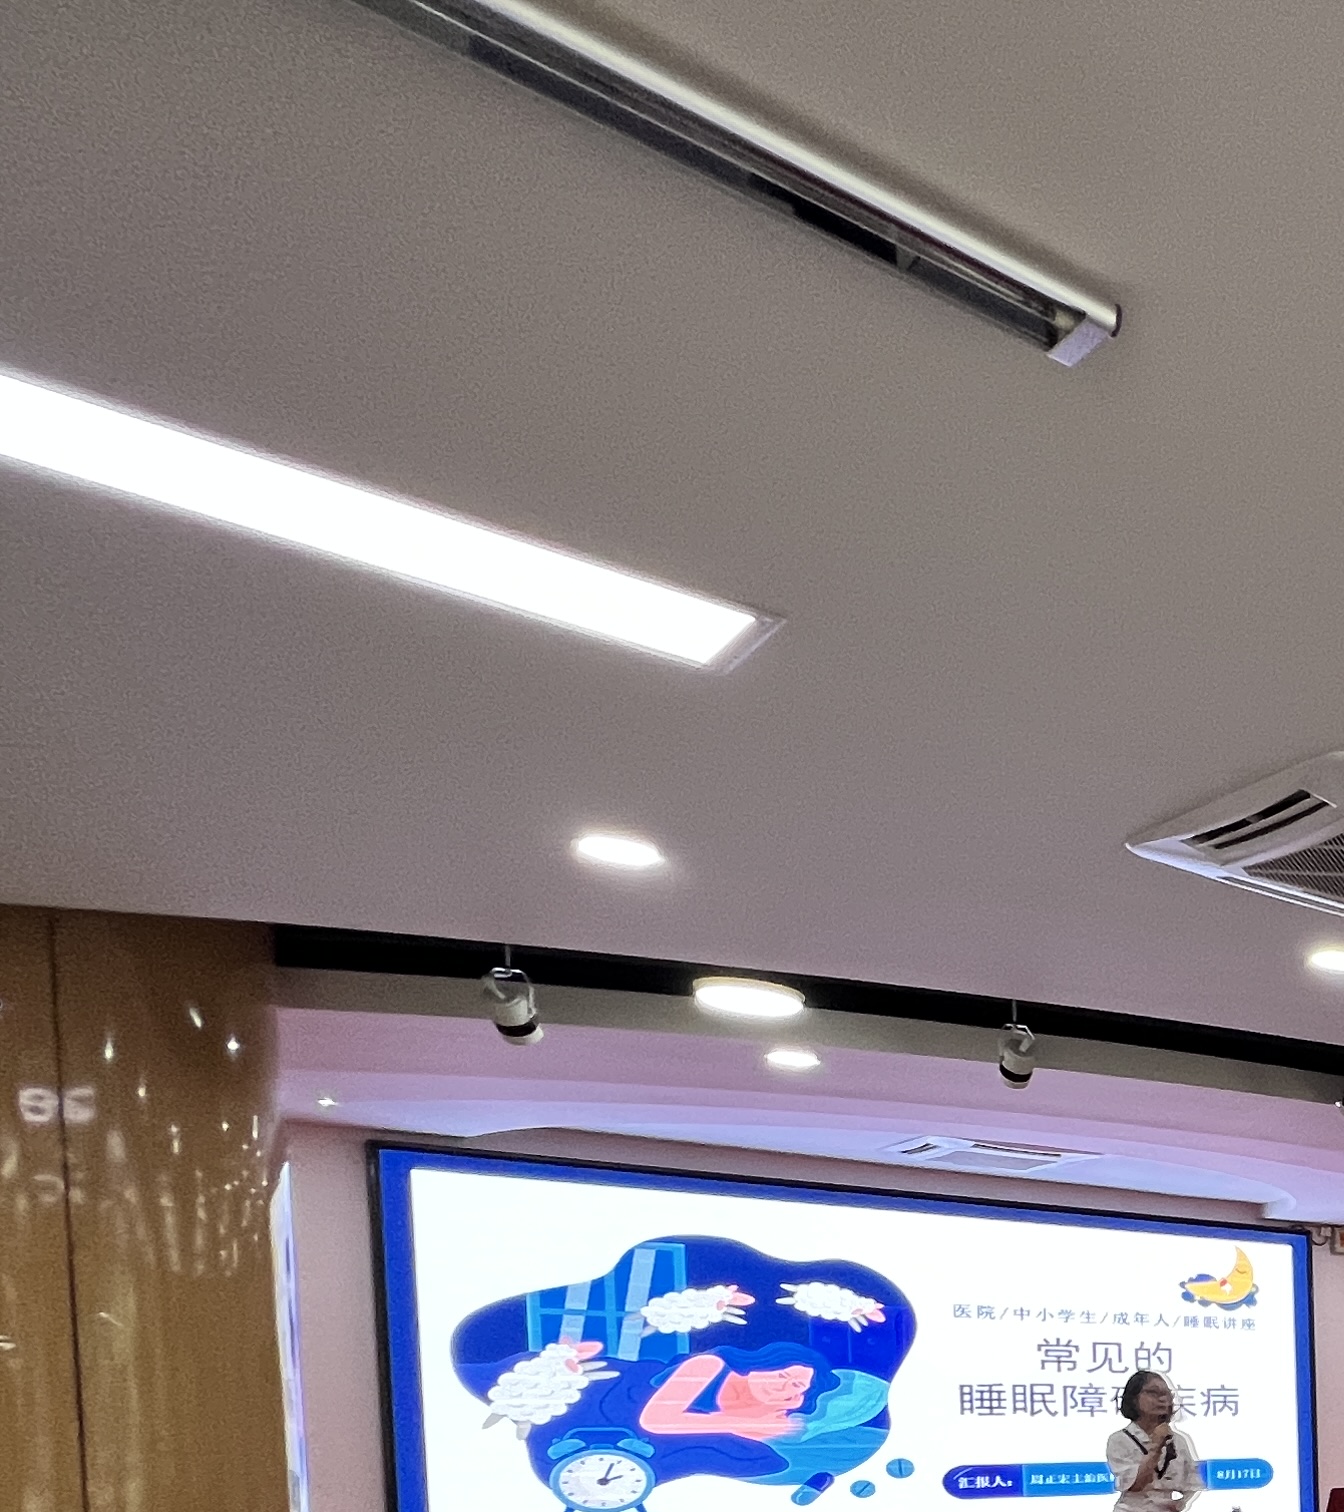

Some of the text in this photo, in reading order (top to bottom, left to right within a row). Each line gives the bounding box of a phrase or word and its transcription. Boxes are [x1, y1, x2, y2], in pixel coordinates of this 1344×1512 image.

[953, 1303, 1256, 1331] 医院/中小学生/成年人/睡眠讲座
[1037, 1338, 1173, 1373] 常见的
[958, 1383, 1240, 1418] 睡眠障疾病
[1216, 1468, 1261, 1480] 8月17日
